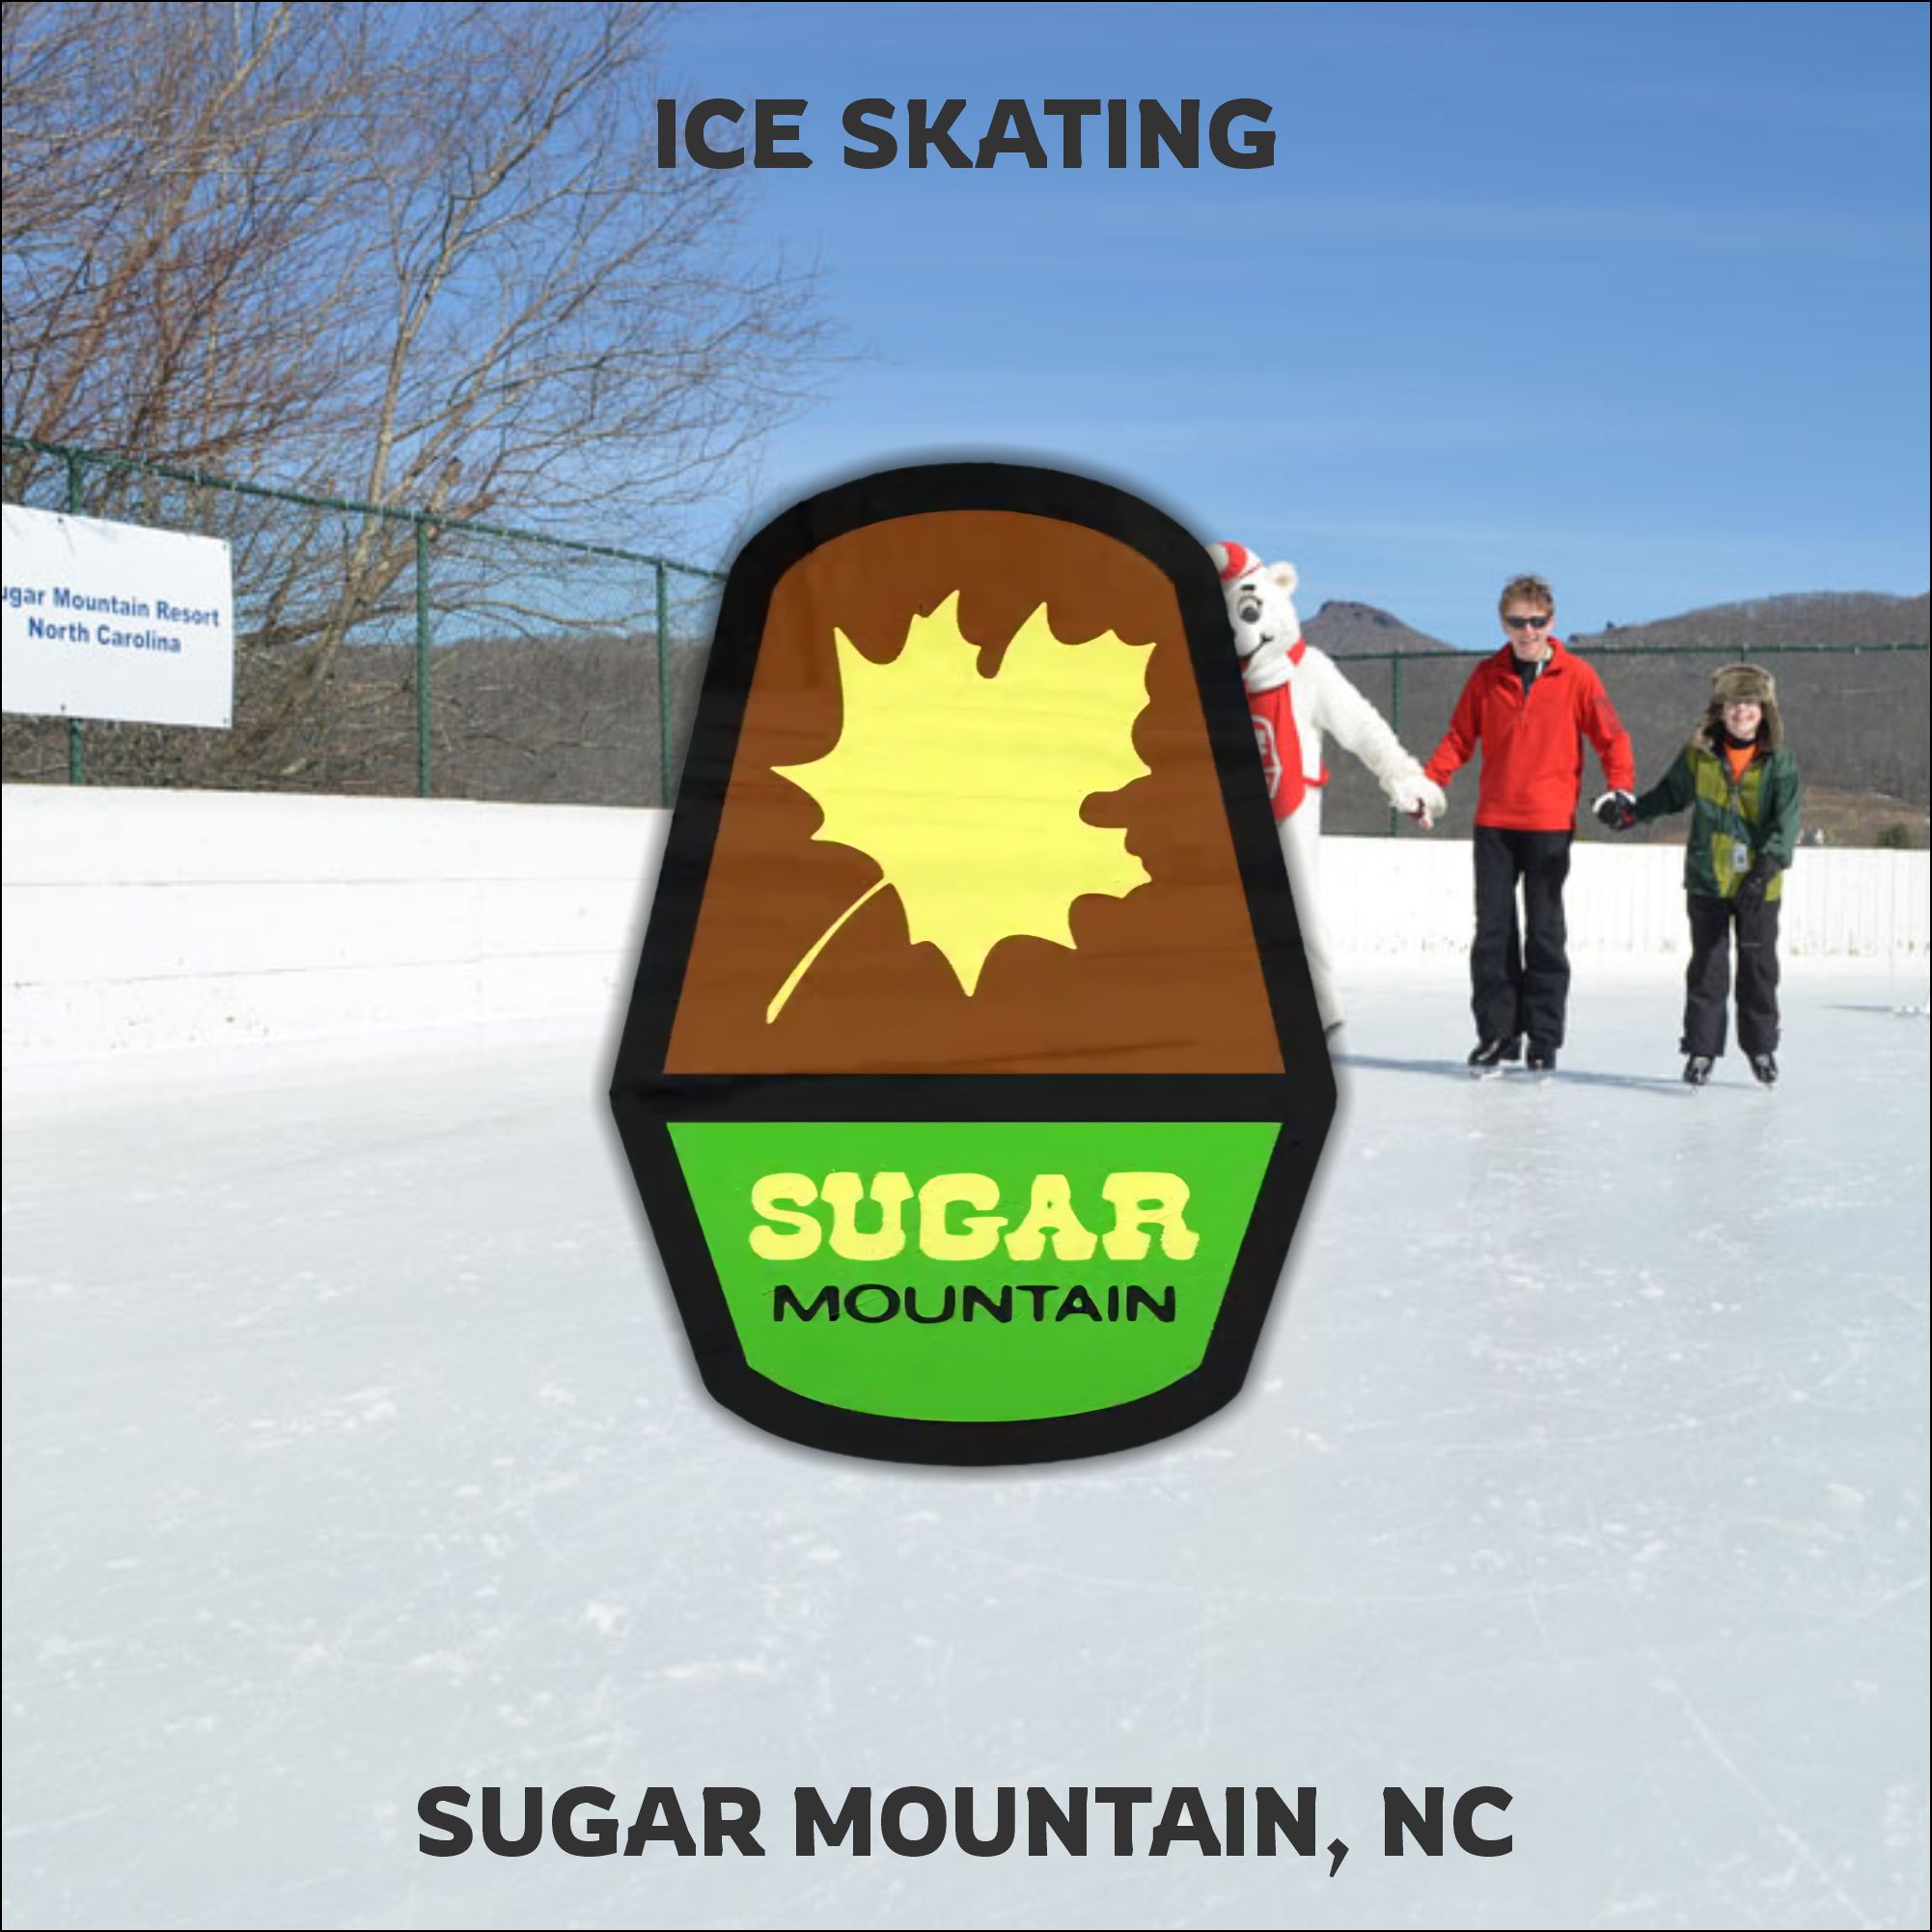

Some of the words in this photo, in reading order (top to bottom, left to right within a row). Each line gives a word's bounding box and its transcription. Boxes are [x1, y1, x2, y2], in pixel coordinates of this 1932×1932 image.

[2, 585, 46, 609] ugar
[53, 587, 151, 618] Mountain
[156, 600, 220, 628] Resort
[28, 616, 90, 643] North
[97, 624, 181, 653] Carolina
